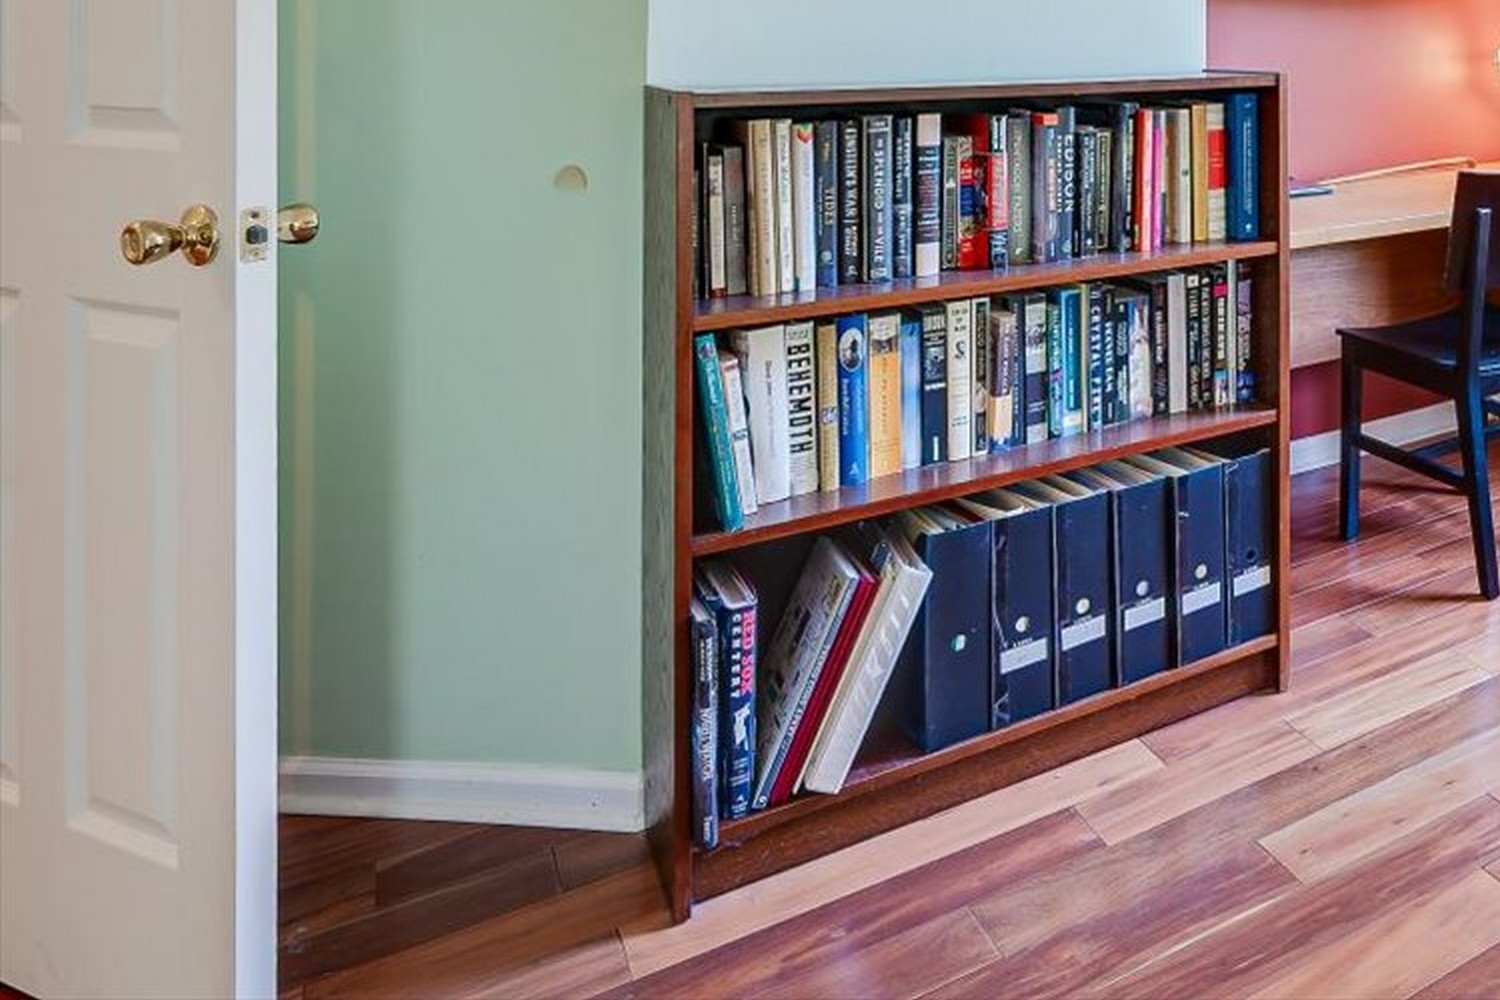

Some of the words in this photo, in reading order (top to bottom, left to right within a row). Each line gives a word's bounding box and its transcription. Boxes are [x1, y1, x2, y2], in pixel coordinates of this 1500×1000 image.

[1065, 134, 1074, 213] EDISON
[1090, 306, 1102, 366] CRYSTAL
[787, 343, 813, 454] BEHEMOTH
[731, 614, 741, 699] CENTURY
[742, 609, 756, 650] RED
[741, 657, 754, 696] SOX
